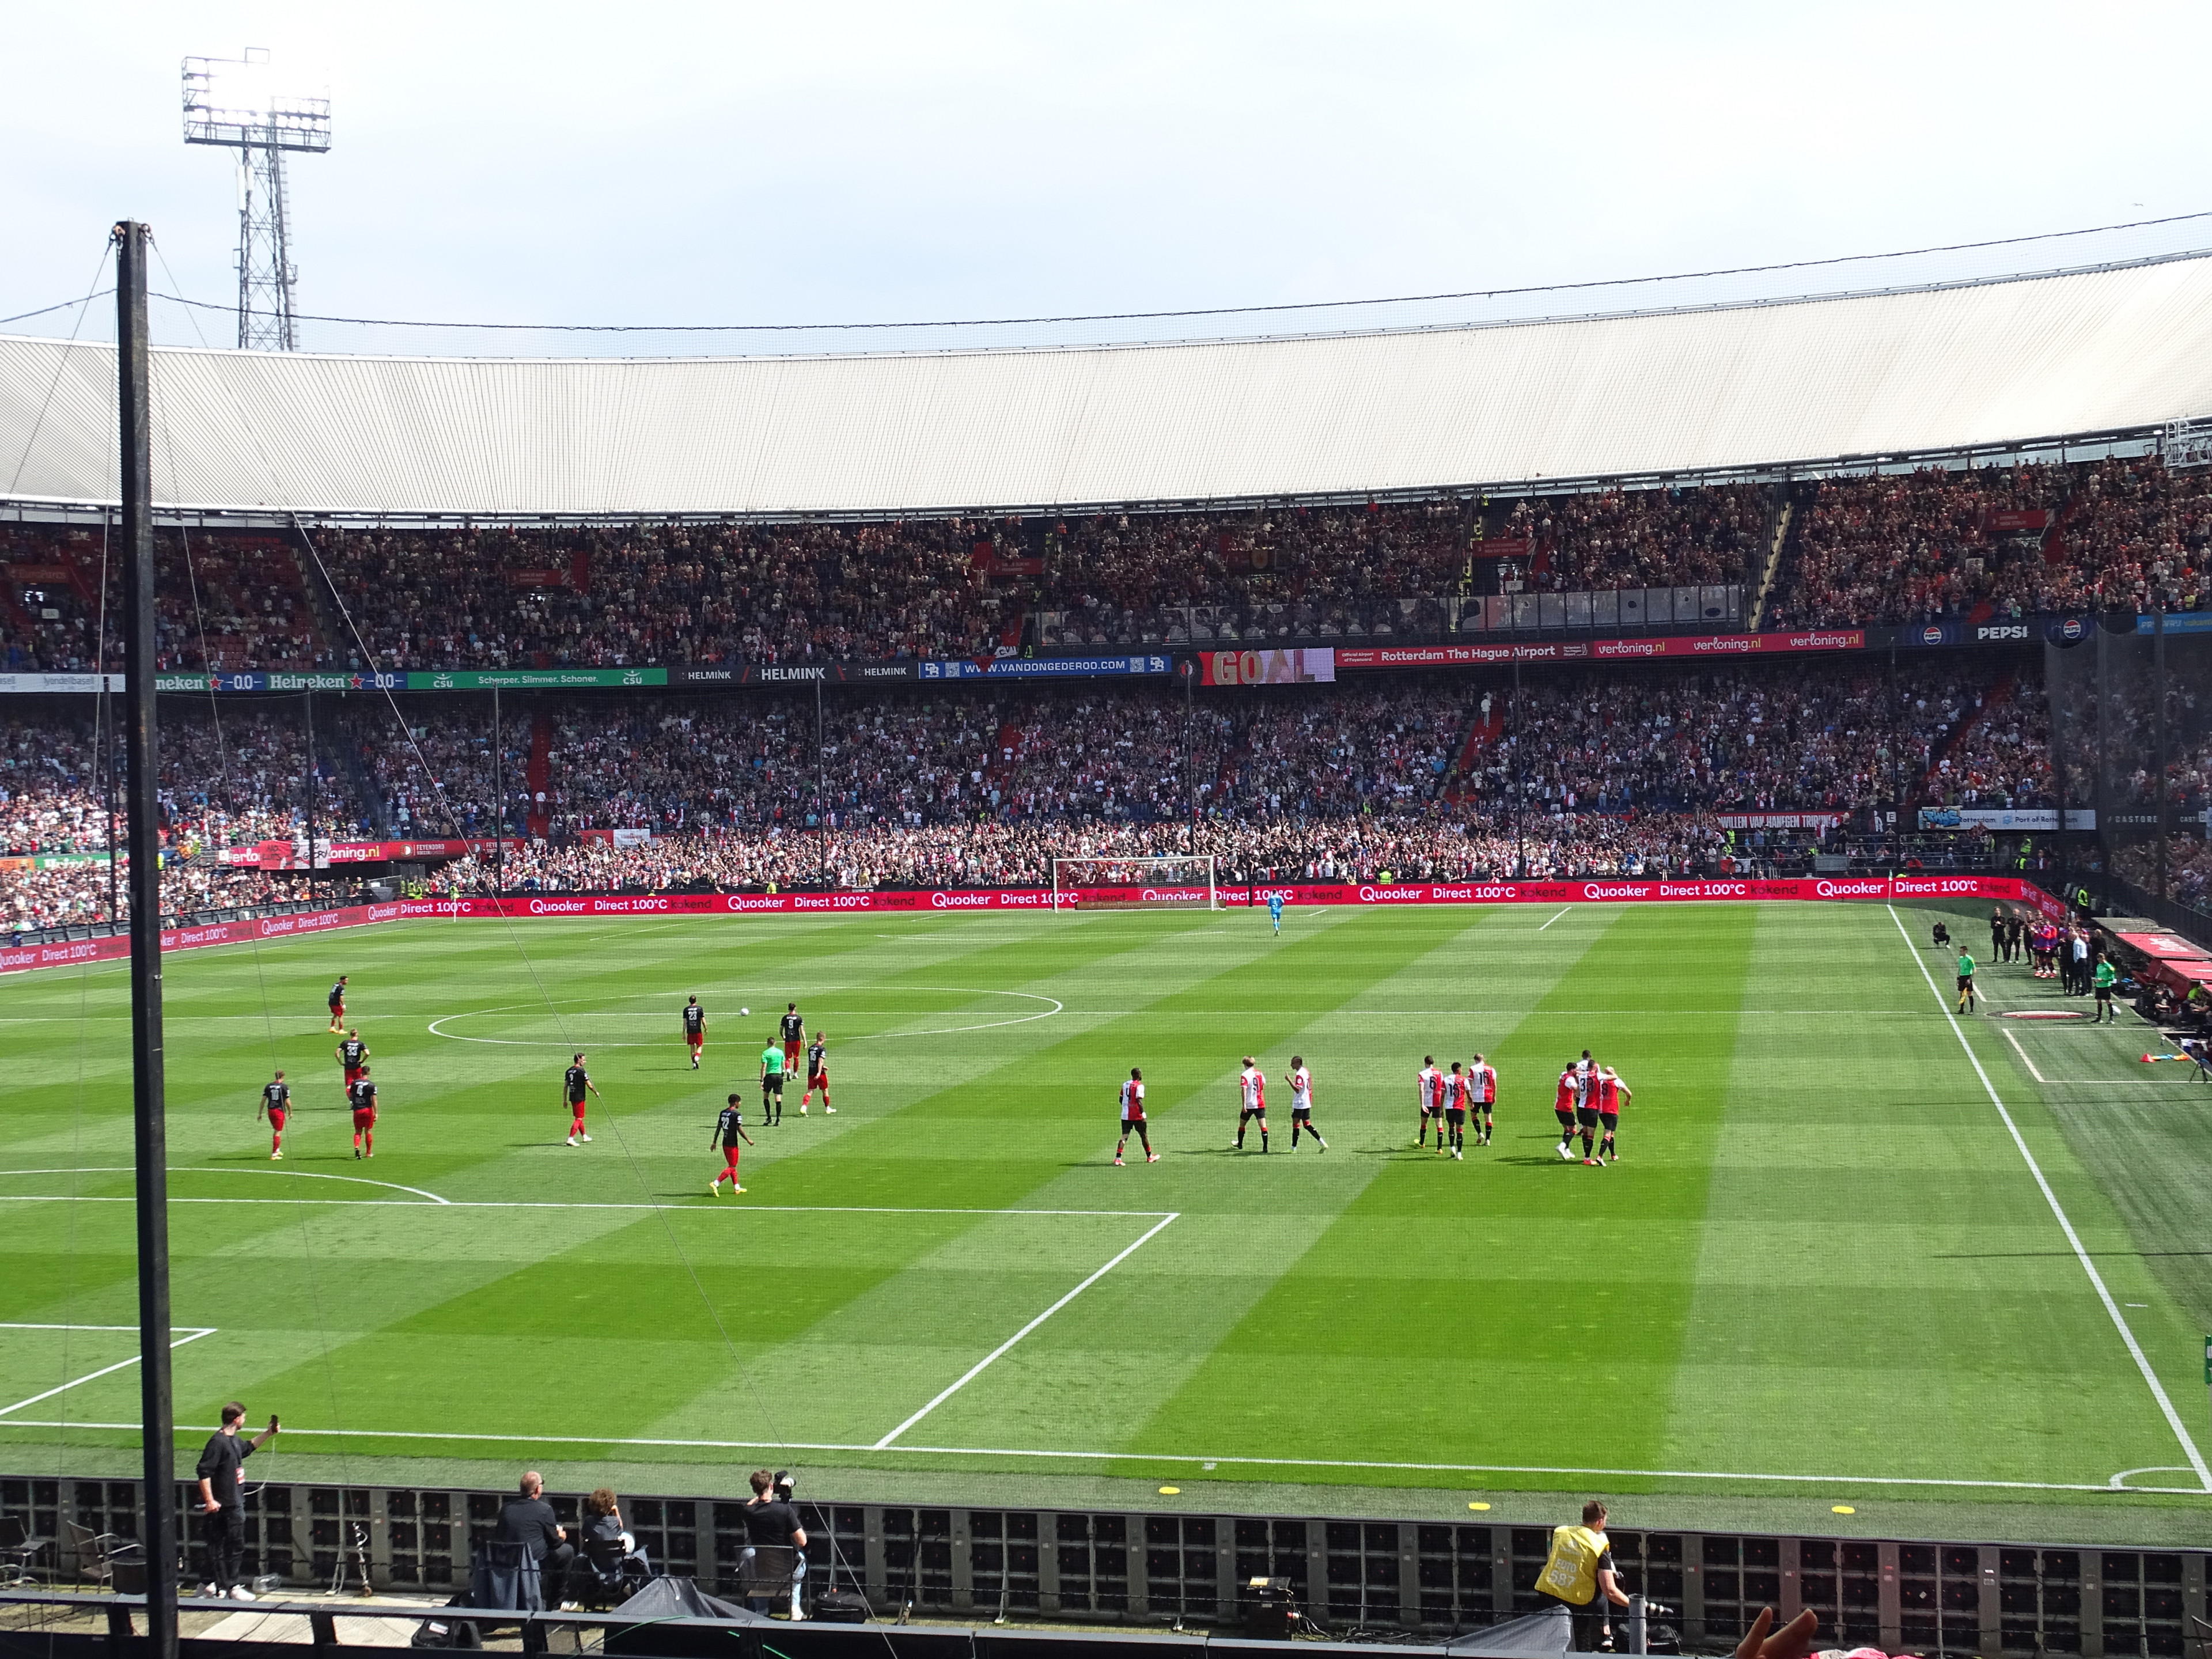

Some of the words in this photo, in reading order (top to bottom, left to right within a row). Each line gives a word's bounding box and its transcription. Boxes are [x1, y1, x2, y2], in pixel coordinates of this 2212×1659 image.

[1978, 626, 2028, 639] PEPSI
[1694, 637, 1761, 651] verloning.nl
[1790, 633, 1859, 647] verloning.nl
[1381, 650, 1444, 661] Rotterdam
[1446, 648, 1469, 659] The
[1472, 647, 1509, 660] Hague
[1512, 646, 1555, 659] Airport
[1599, 641, 1665, 654] verloning.nl
[762, 668, 825, 680] HELMINK
[864, 667, 907, 676] HELMINK
[1212, 649, 1315, 685] GOAL
[270, 675, 345, 688] Heineken
[375, 673, 394, 688] 00
[478, 676, 520, 685] Scherper.
[560, 675, 598, 683] Schoner.
[688, 671, 731, 680] HELMINK
[156, 676, 204, 690] neken
[1721, 816, 1747, 828] WILLEM
[1749, 816, 1764, 828] VAN
[1766, 815, 1800, 828] HANEGEM
[303, 850, 327, 859] GORY
[327, 846, 380, 860] loning.nl
[1142, 889, 1203, 900] Quooker
[1214, 890, 1249, 901] Direct
[1297, 889, 1342, 900] kokend
[1359, 886, 1422, 902] Quooker
[1433, 887, 1471, 898] Direct
[1475, 887, 1516, 898] 100°C
[1520, 887, 1566, 897] kokend
[1584, 883, 1649, 899] Quooker
[1660, 885, 1700, 896] Direct
[1704, 884, 1745, 895] 100°C
[1750, 884, 1798, 894] kokend
[1816, 881, 1884, 897] Quooker
[1895, 881, 1937, 892] Direct
[1941, 880, 1978, 892] 100°C
[529, 899, 585, 914] Quooker
[594, 900, 629, 910] Direct
[631, 899, 668, 910] 100°C
[671, 899, 711, 908] kokend
[728, 896, 785, 911] Quooker
[794, 897, 830, 907] Direct
[833, 896, 870, 907] 100°C
[873, 896, 915, 906] kokend
[931, 892, 991, 908] Quooker
[1001, 893, 1037, 904] Direct
[368, 906, 397, 920] Quooker
[401, 903, 433, 914] Direct
[436, 902, 471, 912] 100°C
[262, 920, 294, 935] Quooker
[298, 917, 317, 928] Direct
[319, 913, 338, 925] 100°C
[181, 931, 204, 944] Direct
[205, 927, 228, 941] 100°C
[42, 949, 68, 961] Direct
[70, 944, 97, 959] 100°C
[688, 1011, 697, 1020] 23
[788, 1020, 794, 1029] 9
[347, 1046, 358, 1056] 33
[1252, 1077, 1260, 1091] 9
[1429, 1076, 1437, 1090] 6
[1580, 1078, 1594, 1092] 33
[356, 1085, 363, 1096] 4
[721, 1116, 730, 1130] 22
[1555, 1557, 1577, 1573] FOTO
[1549, 1569, 1577, 1589] 587
